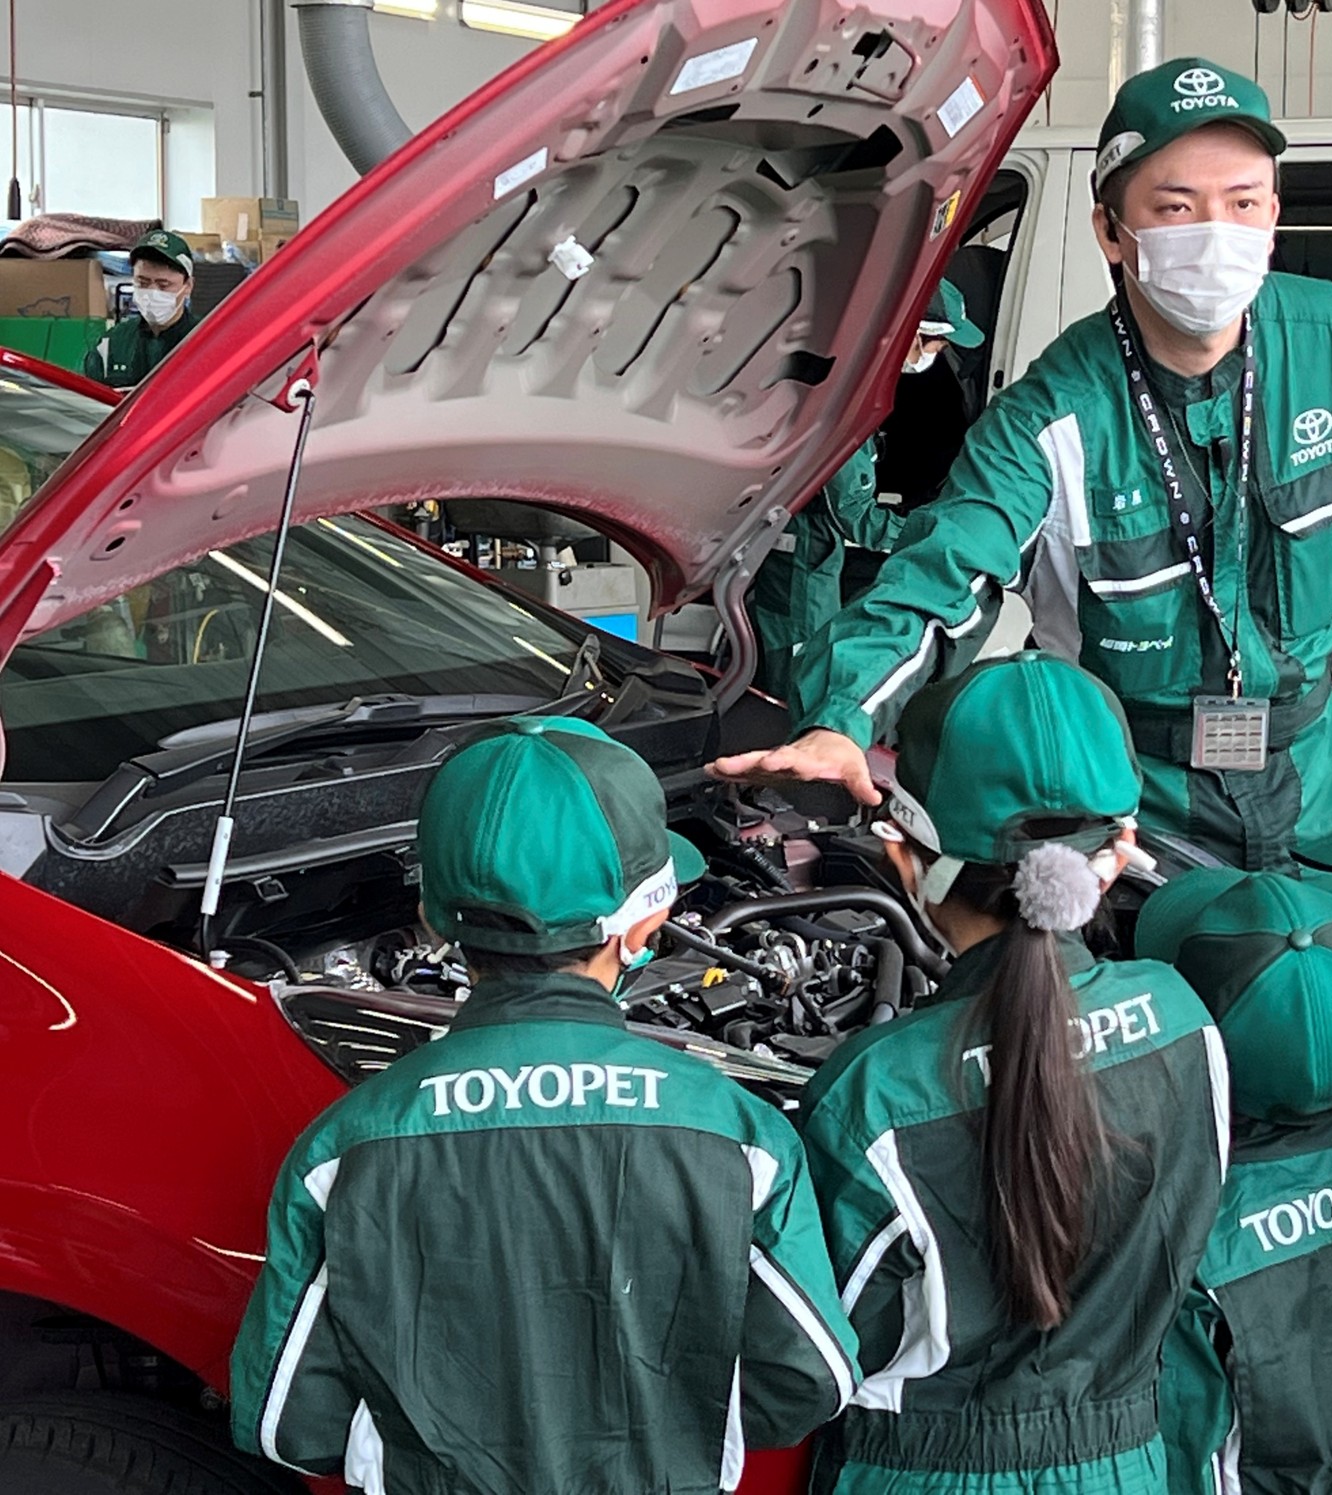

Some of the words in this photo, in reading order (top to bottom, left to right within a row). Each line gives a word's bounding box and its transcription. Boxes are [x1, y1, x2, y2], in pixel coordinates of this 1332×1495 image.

[1170, 95, 1239, 113] TOYOTA
[1138, 393, 1183, 500] CROWN
[643, 876, 676, 908] TOY
[419, 1063, 669, 1116] TOYOPET
